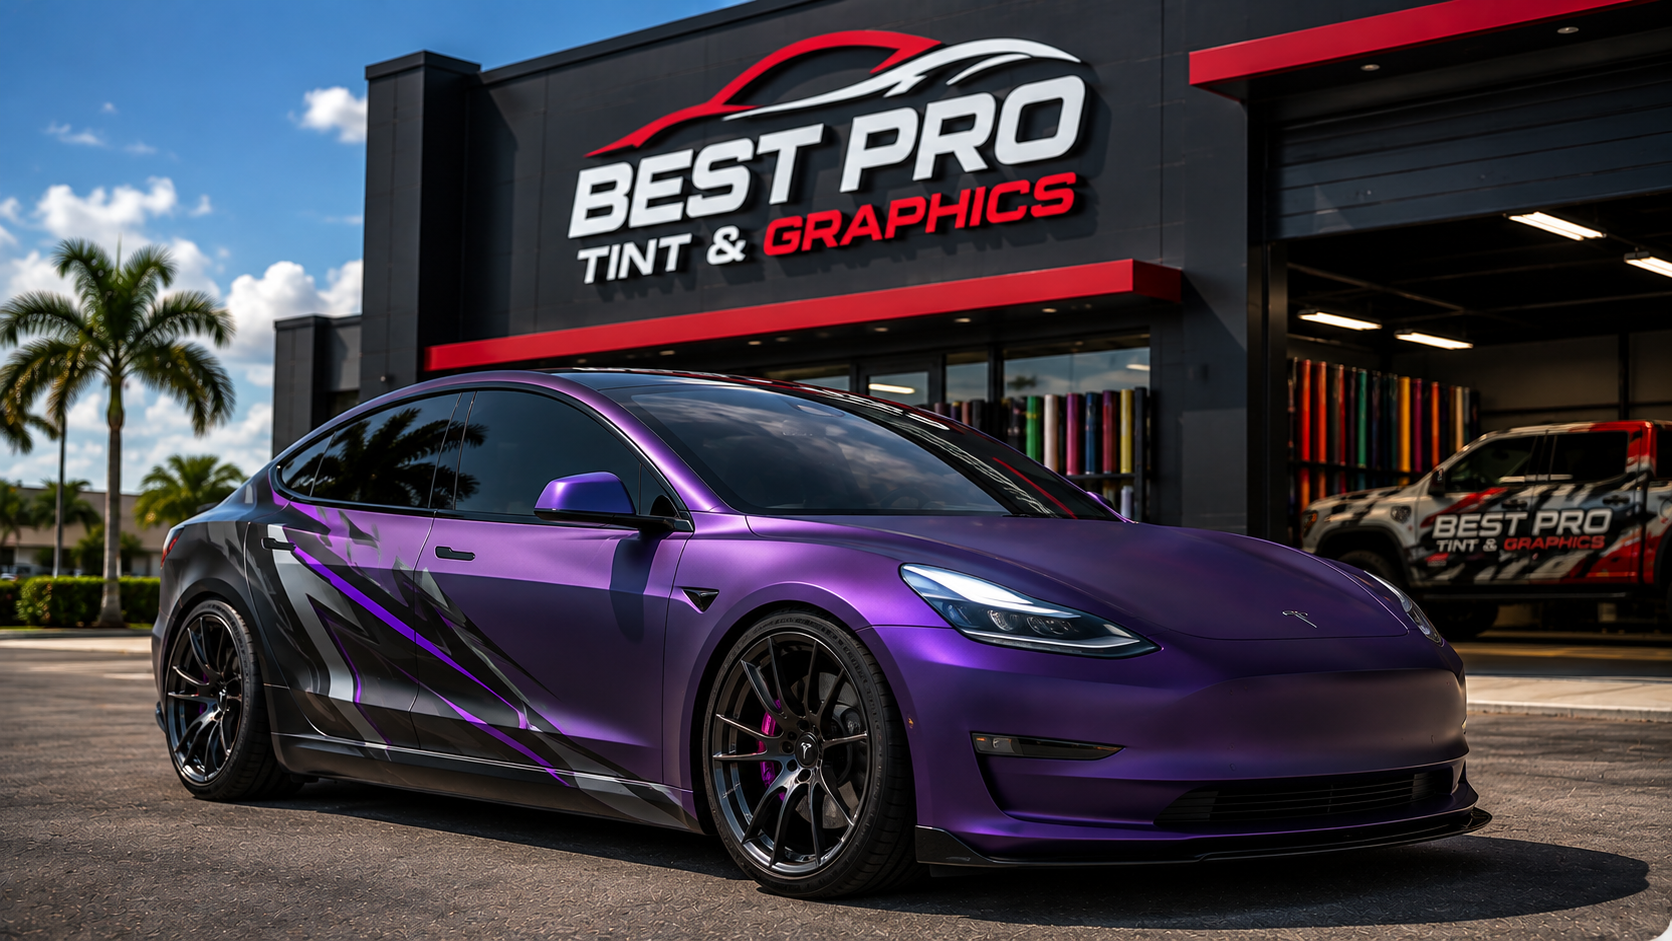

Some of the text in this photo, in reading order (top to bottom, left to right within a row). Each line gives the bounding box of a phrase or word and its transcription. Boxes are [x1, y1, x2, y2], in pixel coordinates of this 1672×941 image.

[568, 75, 1086, 239] BEST PRO
[577, 172, 1076, 284] TINT & GRAPHICS
[1433, 509, 1612, 538] BEST PRO
[1437, 536, 1605, 552] TINT & GRAPHICS
